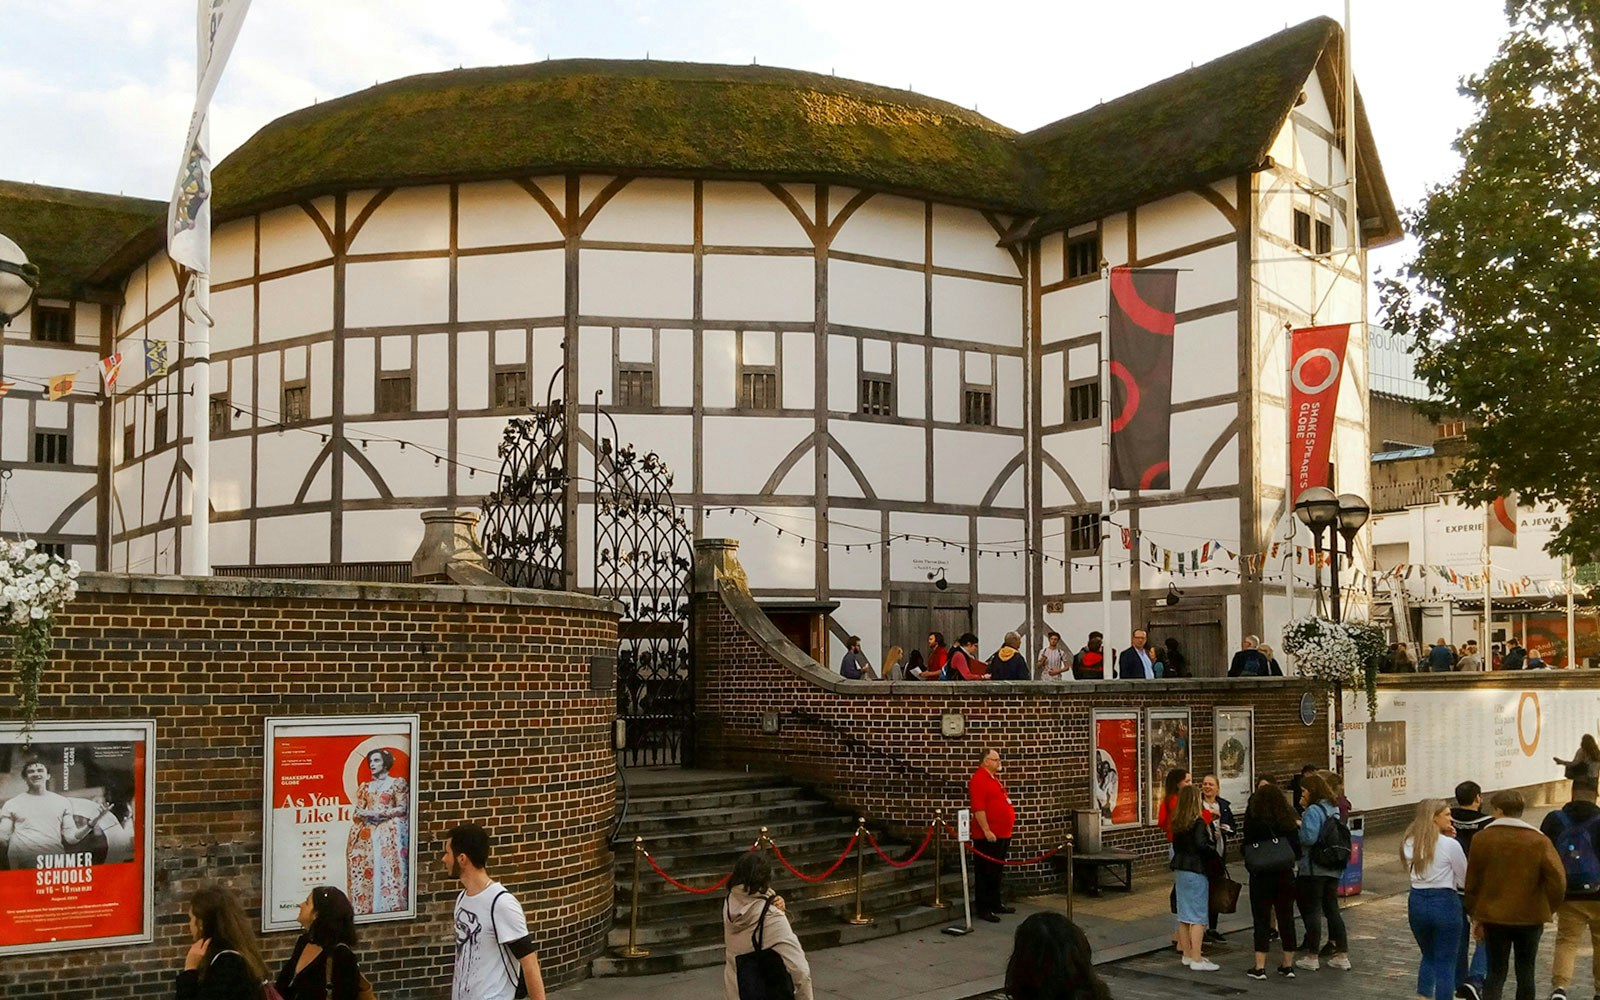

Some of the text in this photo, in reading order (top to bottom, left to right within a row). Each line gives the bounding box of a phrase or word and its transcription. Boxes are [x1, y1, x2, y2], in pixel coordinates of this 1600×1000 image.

[1296, 403, 1311, 439] GLOBE
[1299, 402, 1320, 488] SHAKESPEARE'S
[1445, 523, 1483, 534] EXPERIE
[1392, 777, 1399, 788] AT
[281, 792, 340, 809] As You
[295, 807, 351, 824] Like It
[36, 852, 93, 870] SUMMER
[36, 868, 93, 886] SCHOOLS
[46, 886, 54, 894] 16
[62, 885, 70, 893] 19
